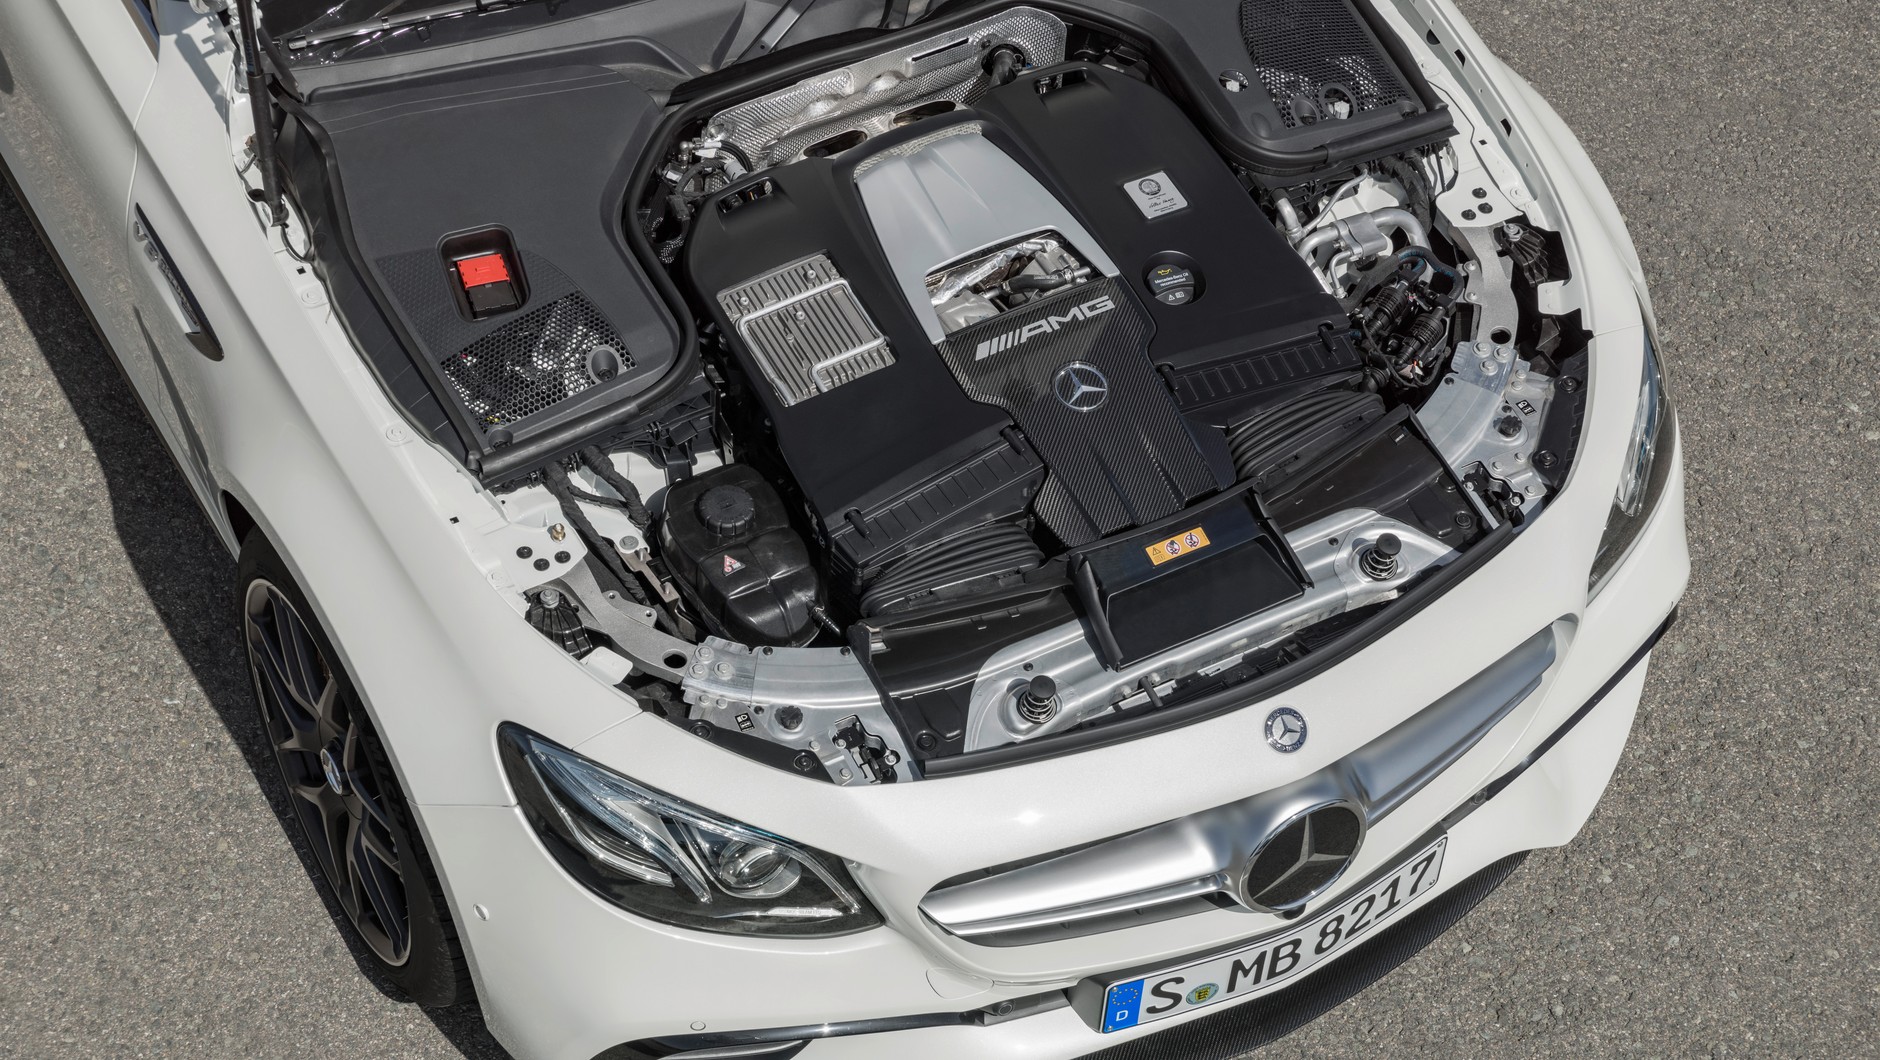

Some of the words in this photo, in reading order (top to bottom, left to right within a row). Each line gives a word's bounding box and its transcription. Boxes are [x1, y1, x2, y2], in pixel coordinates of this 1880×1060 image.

[1020, 295, 1115, 344] AMG
[1146, 976, 1185, 1014] S
[1226, 938, 1302, 994] MB
[1314, 850, 1437, 955] 8217
[1115, 1009, 1129, 1022] D
